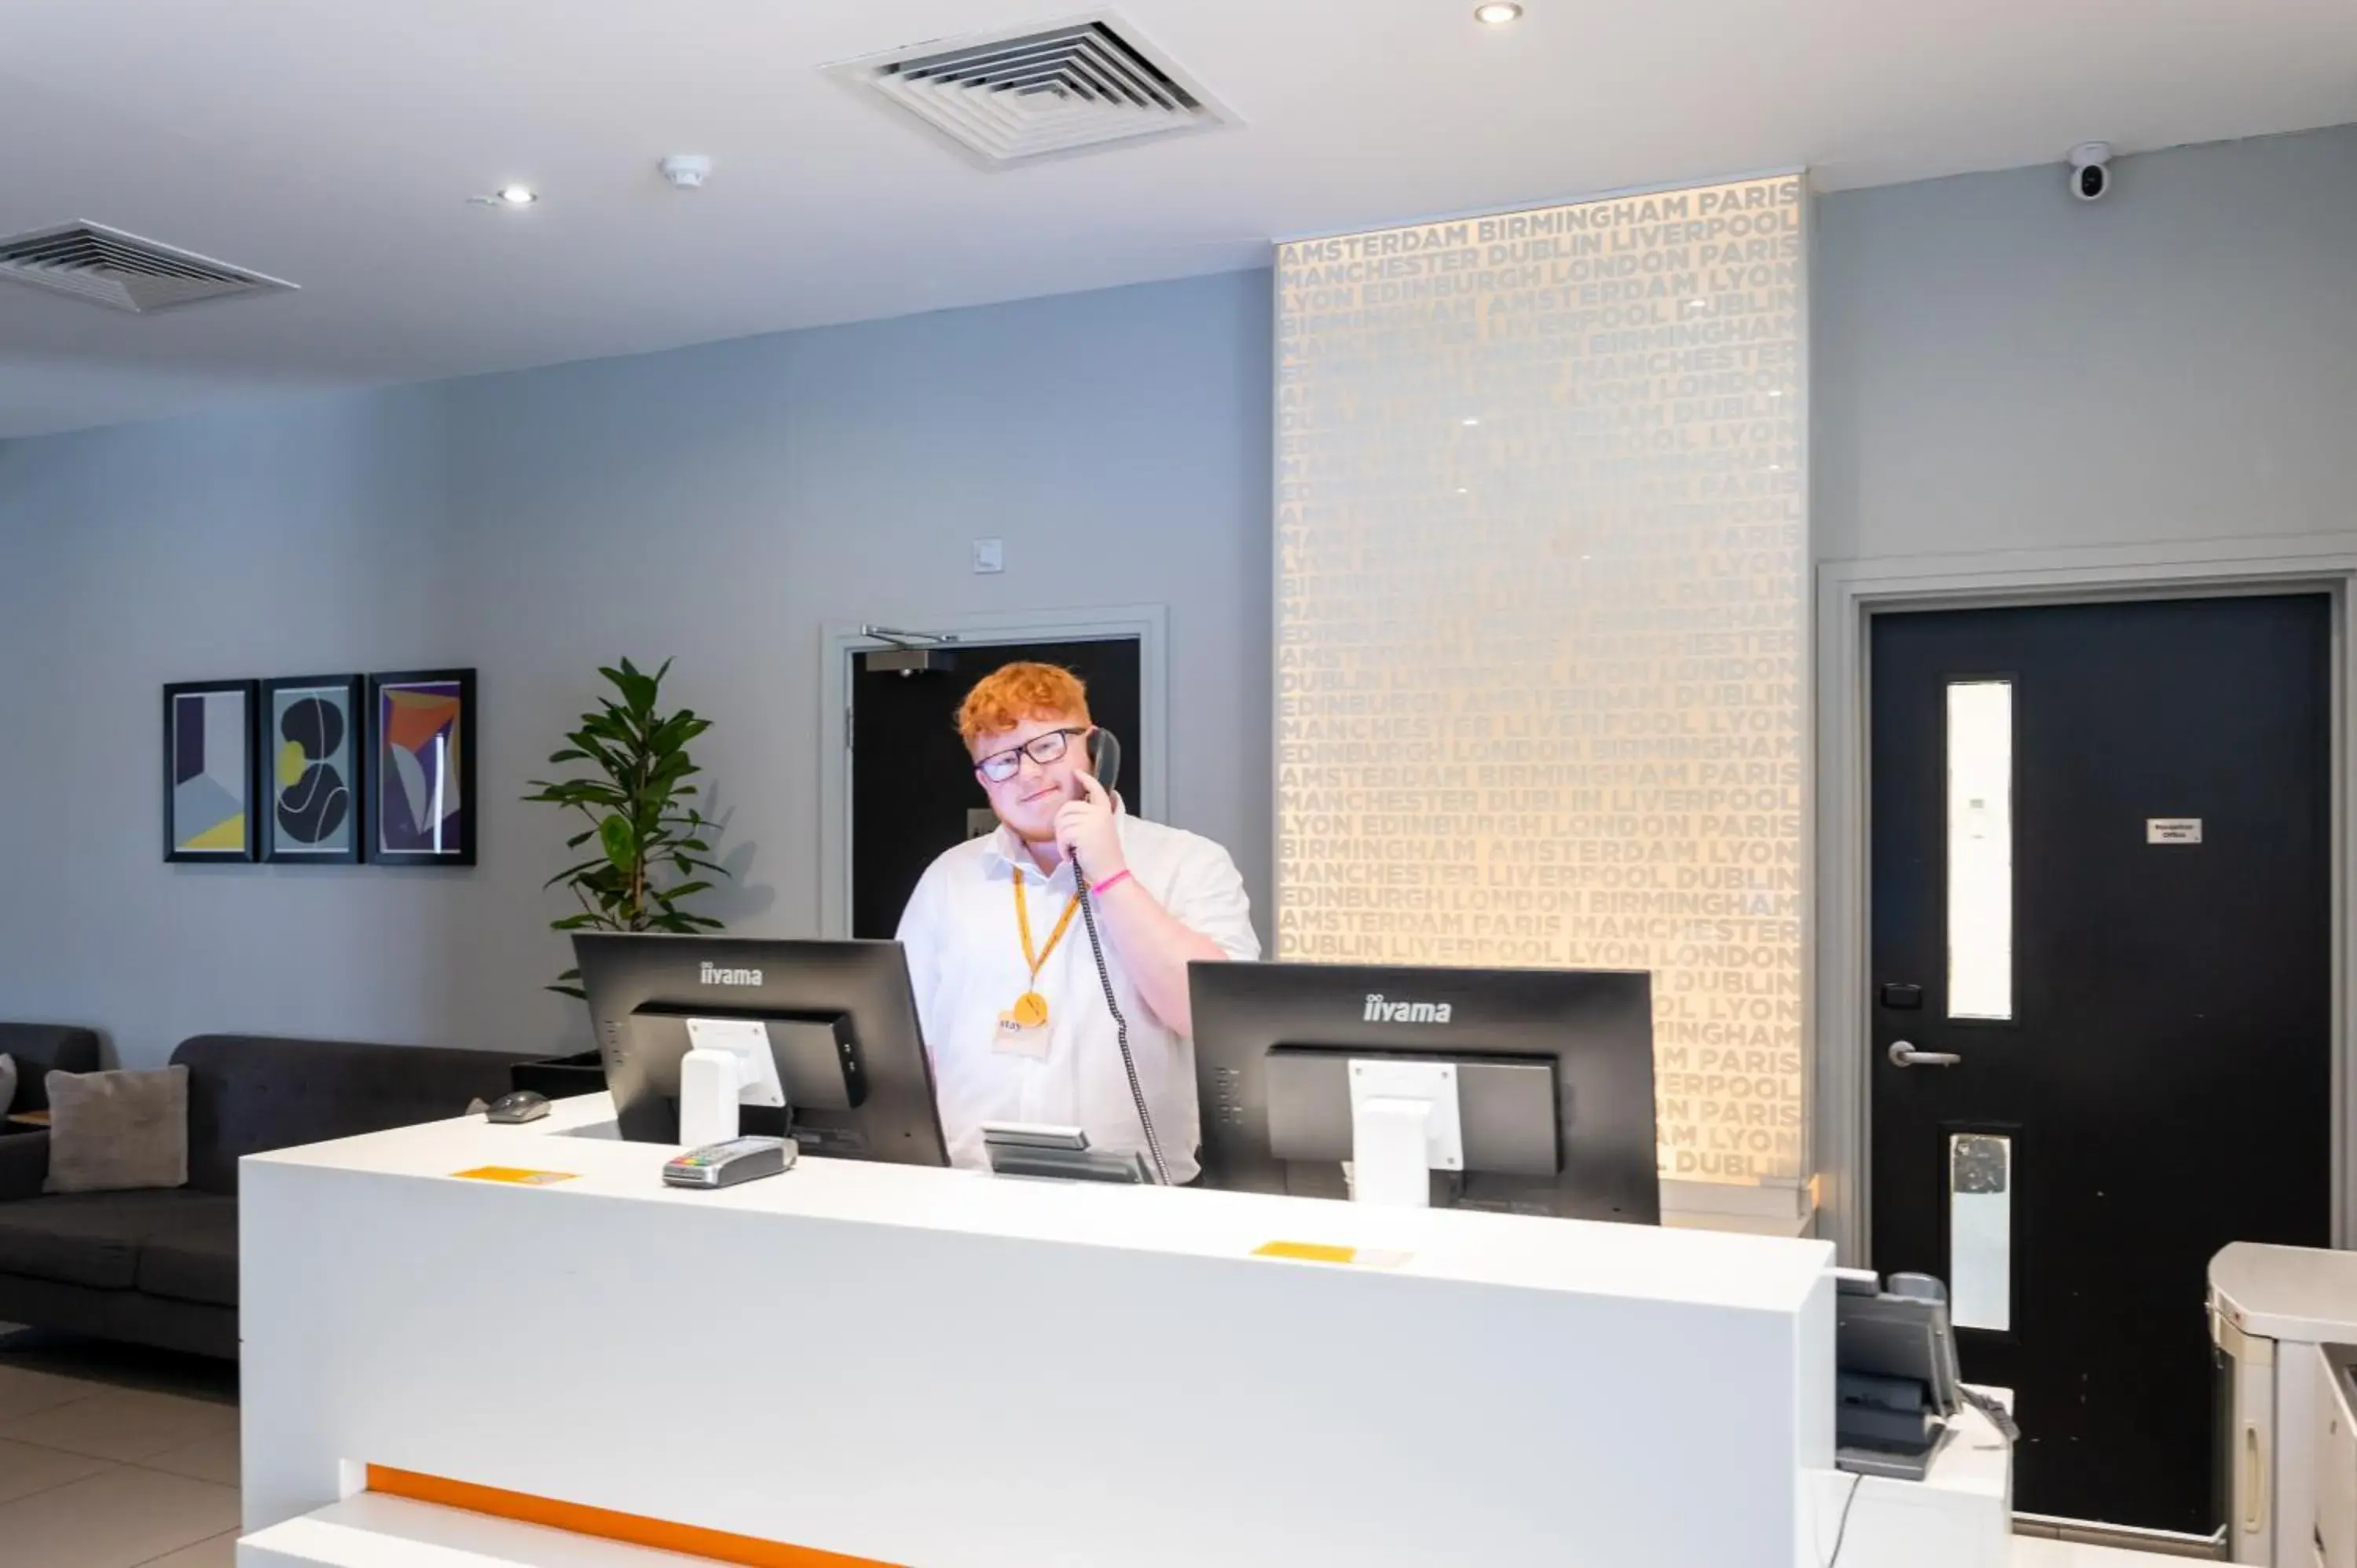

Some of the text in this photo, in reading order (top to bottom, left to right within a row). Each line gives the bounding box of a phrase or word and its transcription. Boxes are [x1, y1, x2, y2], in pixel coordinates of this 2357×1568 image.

[1281, 182, 1798, 266] AMSTERDAM BIRMINGHAM PARIS
[1281, 208, 1799, 289] MANCHESTER DUBLIN LIVERPOOL
[1281, 235, 1798, 313] LYON EDINBURGH LONDON PARIS
[1489, 272, 1697, 314] AMSTERDAM
[1710, 261, 1798, 291] LYON
[1676, 683, 1798, 707] DUBLIN
[1281, 716, 1491, 738] MANCHESTER
[1710, 709, 1798, 732] LYON
[1281, 736, 1798, 762] EDINBURGH LONDON BIRMINGHAM
[1281, 762, 1798, 786] AMSTERDAM BIRMINGHAM PARIS
[1281, 789, 1799, 810] MANCHESTER DUBLIN LIVERPOOL
[1281, 815, 1798, 837] LYON EDINBURGH LONDON PARIS
[1281, 838, 1798, 863] BIRMINGHAM AMSTERDAM LYON
[1281, 862, 1798, 889] MANCHESTER LIVERPOOL DUBLIN
[1281, 885, 1798, 916] EDINBURGH LONDON BIRMINGHAM
[1281, 909, 1798, 942] AMSTERDAM PARIS MANCHESTER
[1281, 933, 1798, 969] DUBLIN LIVERPOOL LYON LONDON
[700, 962, 763, 986] iiyama
[1676, 969, 1798, 995] DUBLIN
[1364, 994, 1451, 1023] iiyama
[1710, 997, 1798, 1021] LYON
[1657, 1020, 1798, 1048] INGHAM
[1699, 1048, 1798, 1075] PARIS
[1662, 1072, 1799, 1101] ERPOOL
[1700, 1101, 1798, 1127] PARIS
[1710, 1127, 1798, 1154] LYON
